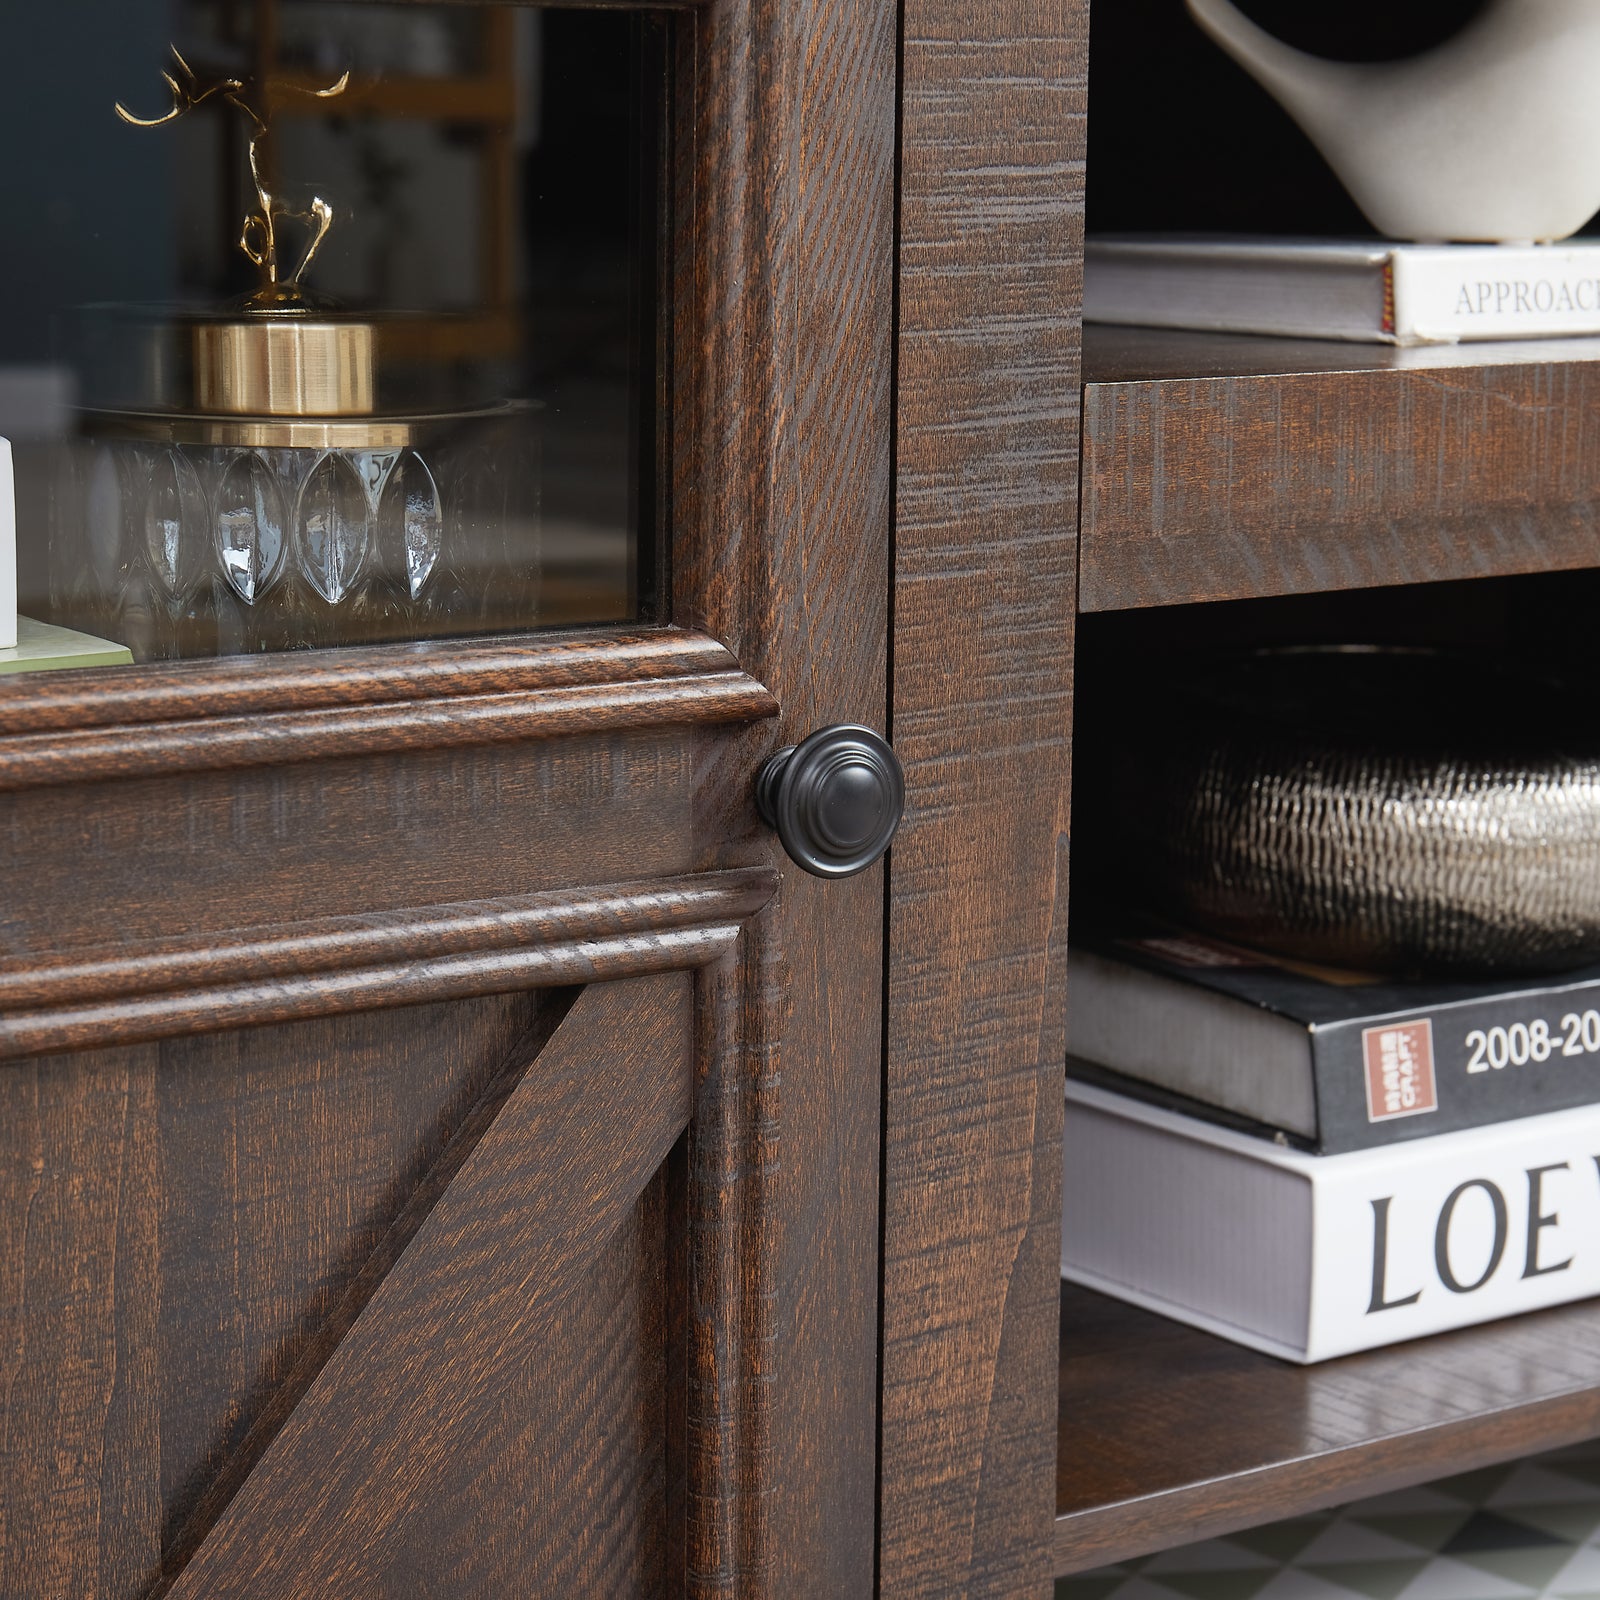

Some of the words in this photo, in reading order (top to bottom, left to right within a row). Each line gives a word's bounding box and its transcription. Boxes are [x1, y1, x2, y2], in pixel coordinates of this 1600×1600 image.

[1455, 278, 1600, 315] APPROAC
[1465, 1009, 1600, 1074] 2008-20
[1365, 1155, 1600, 1315] LOE
